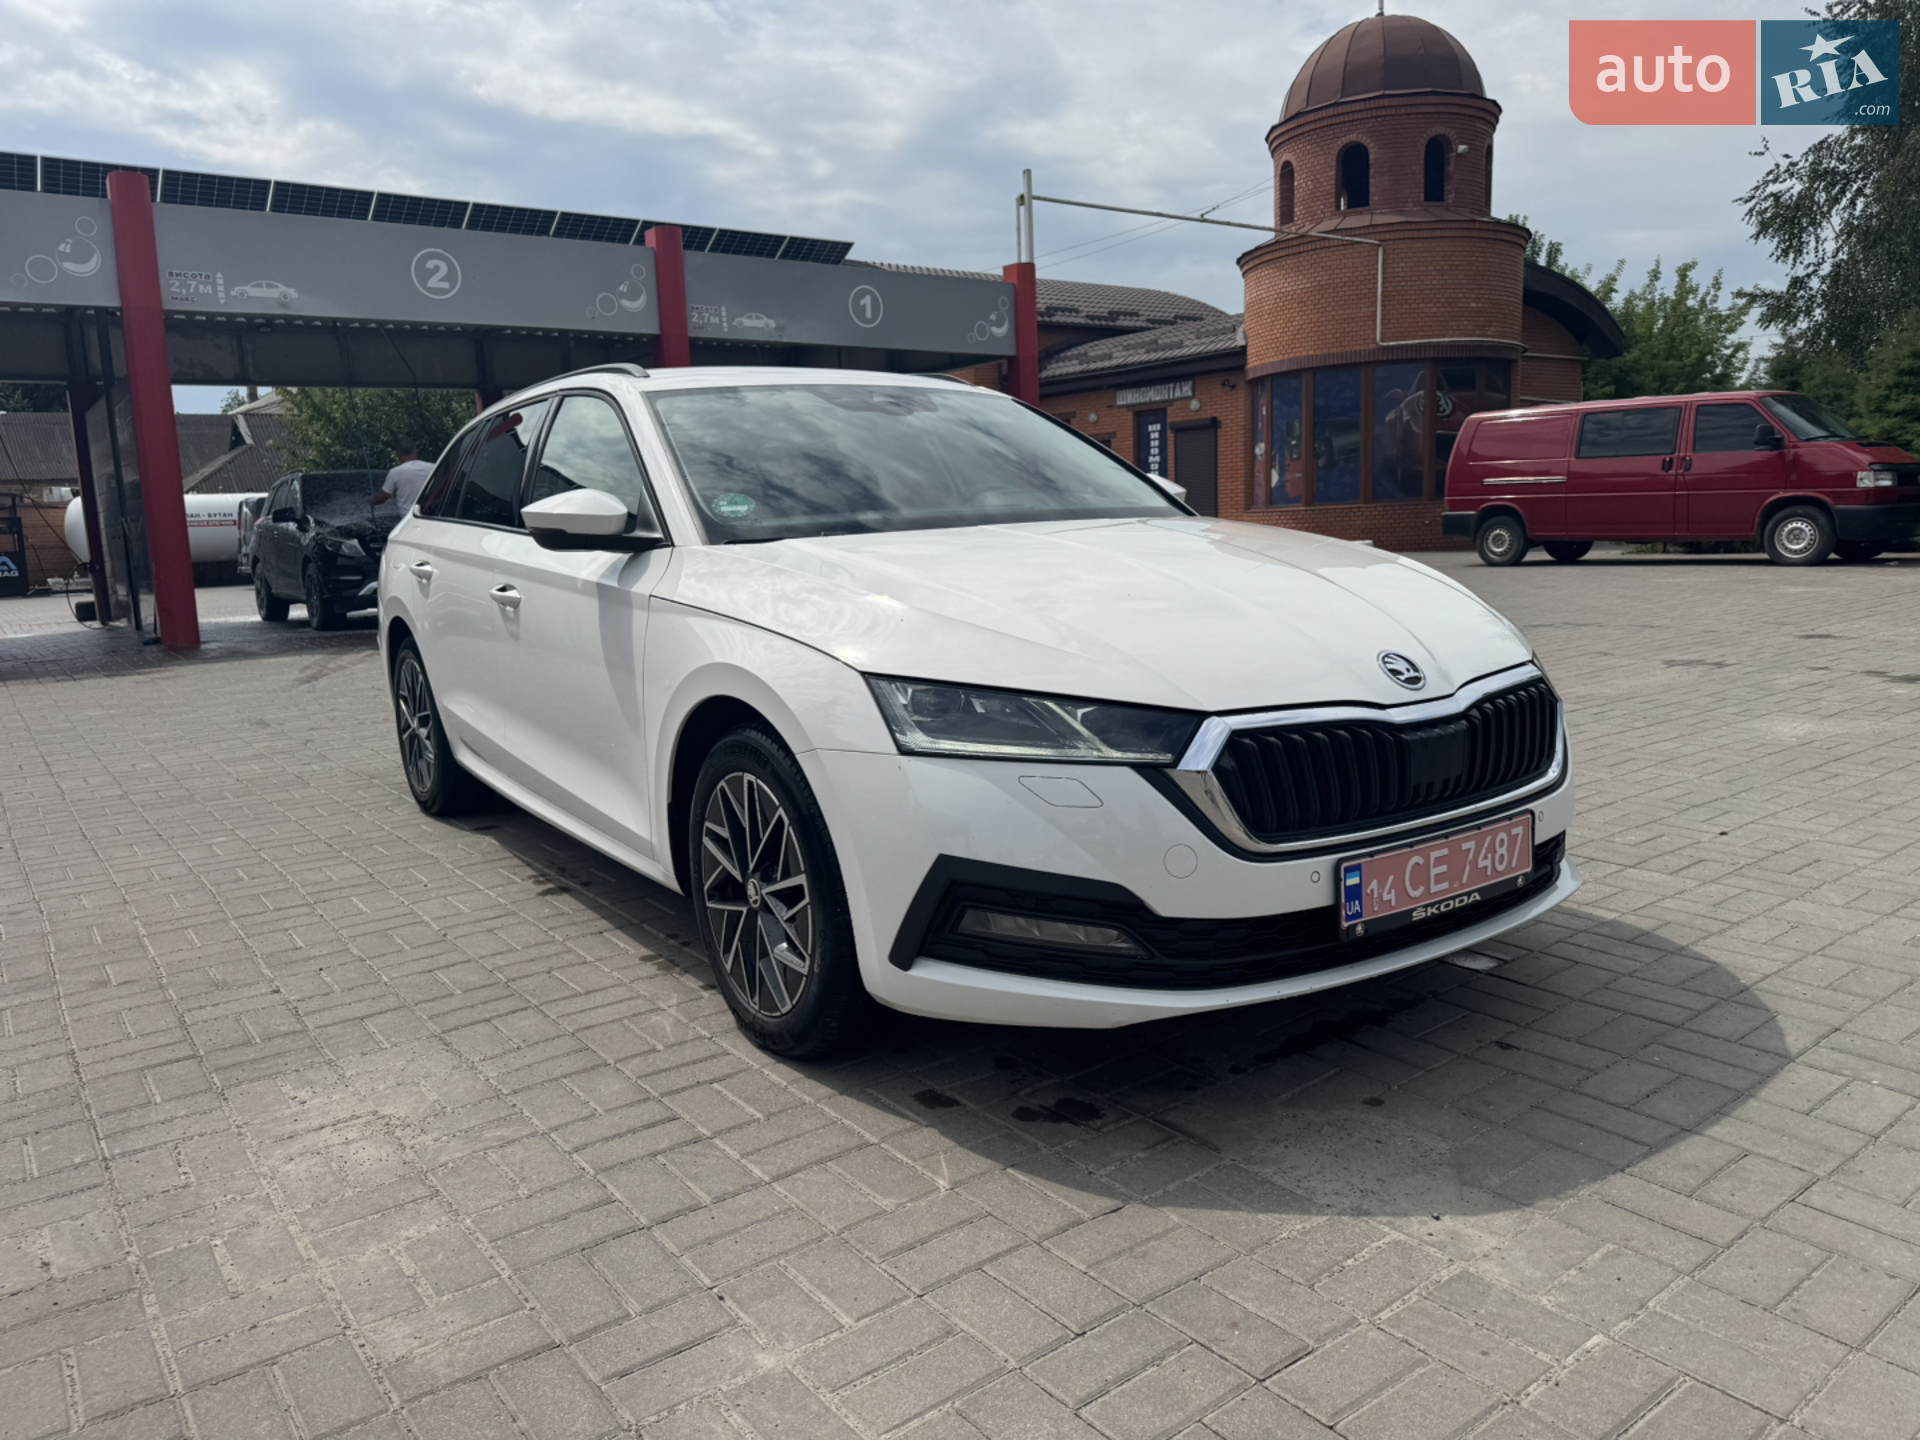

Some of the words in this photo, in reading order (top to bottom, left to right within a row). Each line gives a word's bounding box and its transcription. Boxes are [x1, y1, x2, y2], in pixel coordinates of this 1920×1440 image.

[425, 259, 450, 289] 2
[859, 294, 872, 319] 1
[1116, 380, 1193, 405] ШИНОМОНТАЖ
[1367, 875, 1396, 912] 14
[1404, 847, 1450, 899] CE
[1461, 826, 1524, 885] 7487
[1346, 900, 1361, 916] UA
[1412, 892, 1481, 921] ŠKODA
